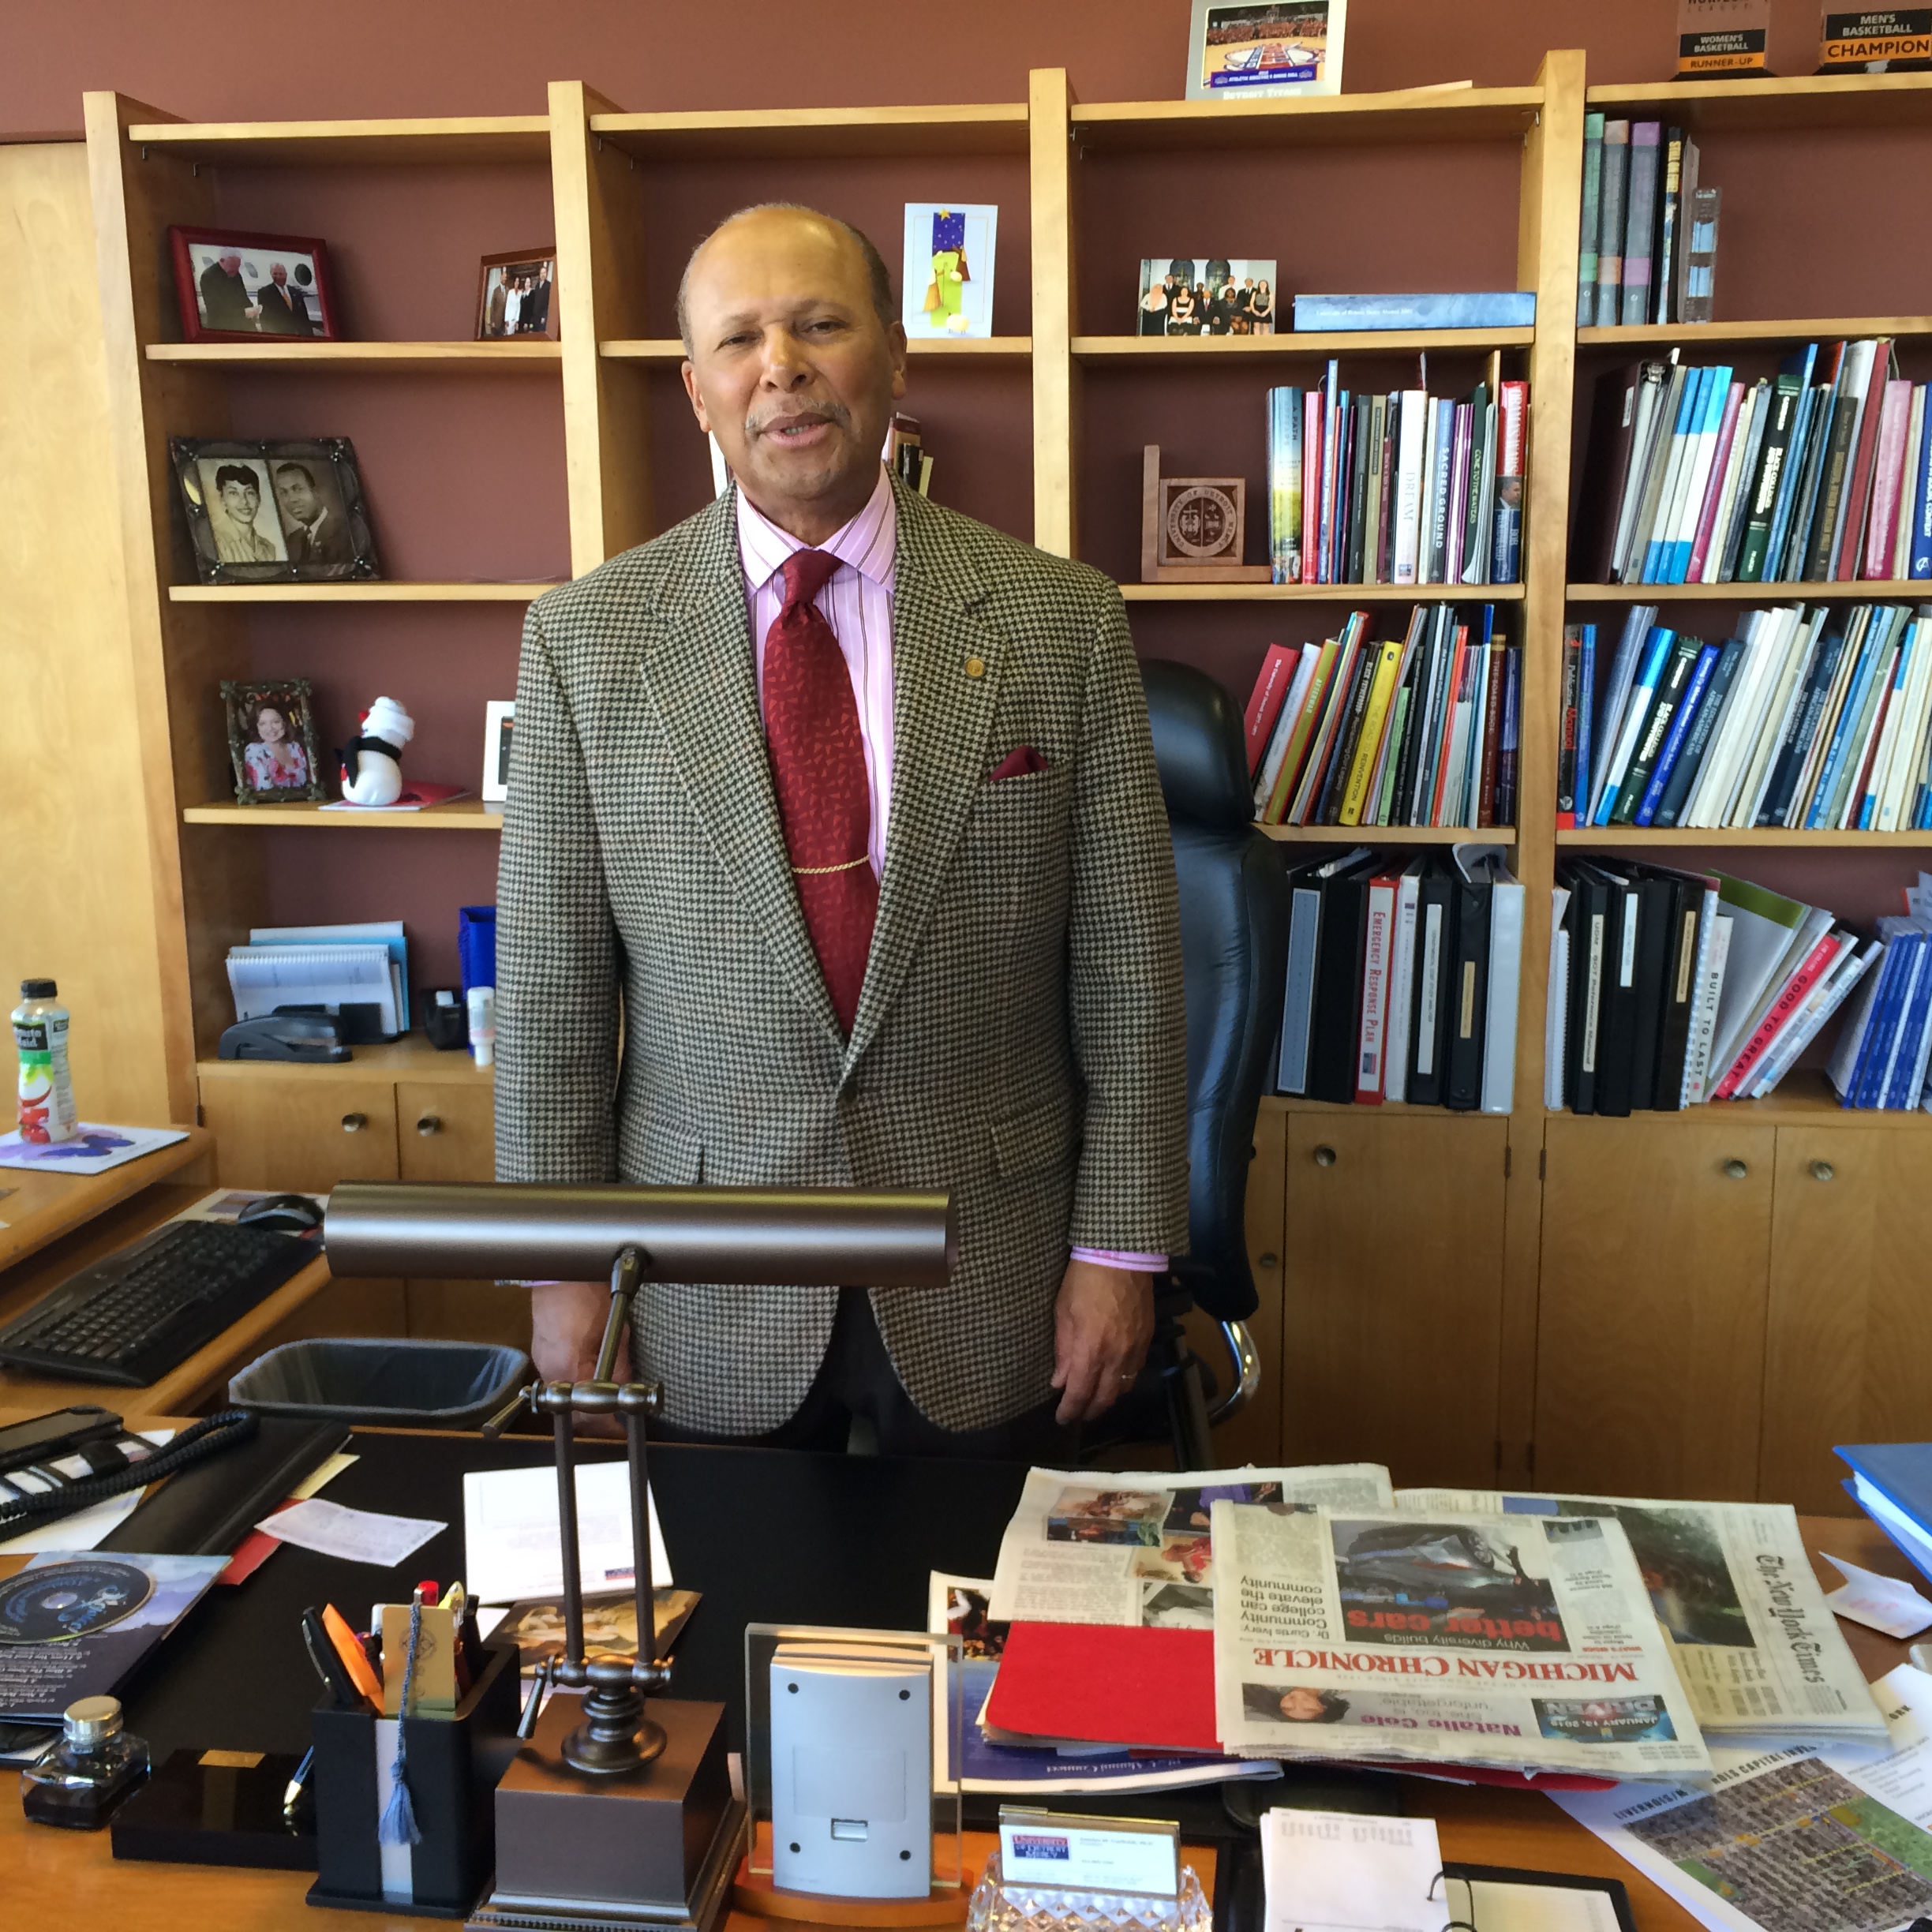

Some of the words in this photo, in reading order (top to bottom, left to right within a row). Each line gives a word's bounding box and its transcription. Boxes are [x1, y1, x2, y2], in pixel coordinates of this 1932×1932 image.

[1860, 14, 1895, 24] MEN'S
[1700, 34, 1743, 43] WOMEN'S
[1842, 24, 1912, 36] BASKETBALL
[1694, 42, 1748, 53] BASKETBALL
[1690, 57, 1753, 69] RUNNER-UP
[1440, 447, 1449, 495] SACRED
[1403, 472, 1416, 521] DREAM
[1436, 498, 1446, 549] GROUND
[1510, 529, 1519, 545] BOB
[1305, 678, 1322, 713] AFTERWAR
[1565, 707, 1577, 750] Manual
[1351, 753, 1368, 801] REINVENTION
[1370, 912, 1386, 964] EMERGENCY
[1367, 969, 1381, 1013] RESPONSE
[1705, 972, 1719, 1011] BUILT
[1779, 975, 1808, 1010] GOOD
[1365, 1019, 1378, 1043] PLAN
[1702, 1020, 1711, 1035] TO
[1763, 1017, 1780, 1032] TO
[1695, 1042, 1707, 1076] LAST
[1730, 1037, 1763, 1078] GREAT
[1756, 1555, 1786, 1578] The
[1240, 1575, 1322, 1595] community
[1241, 1587, 1264, 1600] the
[1763, 1580, 1794, 1606] New
[1241, 1600, 1268, 1611] can
[1268, 1591, 1323, 1605] elevate
[1240, 1611, 1327, 1628] Community
[1271, 1603, 1325, 1617] college
[1347, 1609, 1430, 1631] cars
[1275, 1628, 1310, 1638] Curtis
[1443, 1618, 1562, 1642] better
[1769, 1607, 1813, 1639] York
[1384, 1634, 1428, 1645] builds
[1433, 1634, 1492, 1647] diversity
[1496, 1638, 1530, 1651] Why
[1253, 1647, 1450, 1677] CHRONICLE
[1456, 1658, 1639, 1683] MICHIGAN
[1791, 1642, 1825, 1683] Times
[1361, 1715, 1417, 1729] Cole
[1428, 1719, 1522, 1736] Natalie
[1603, 1717, 1657, 1728] JANUARY
[1739, 1754, 1784, 1774] CAPITAL
